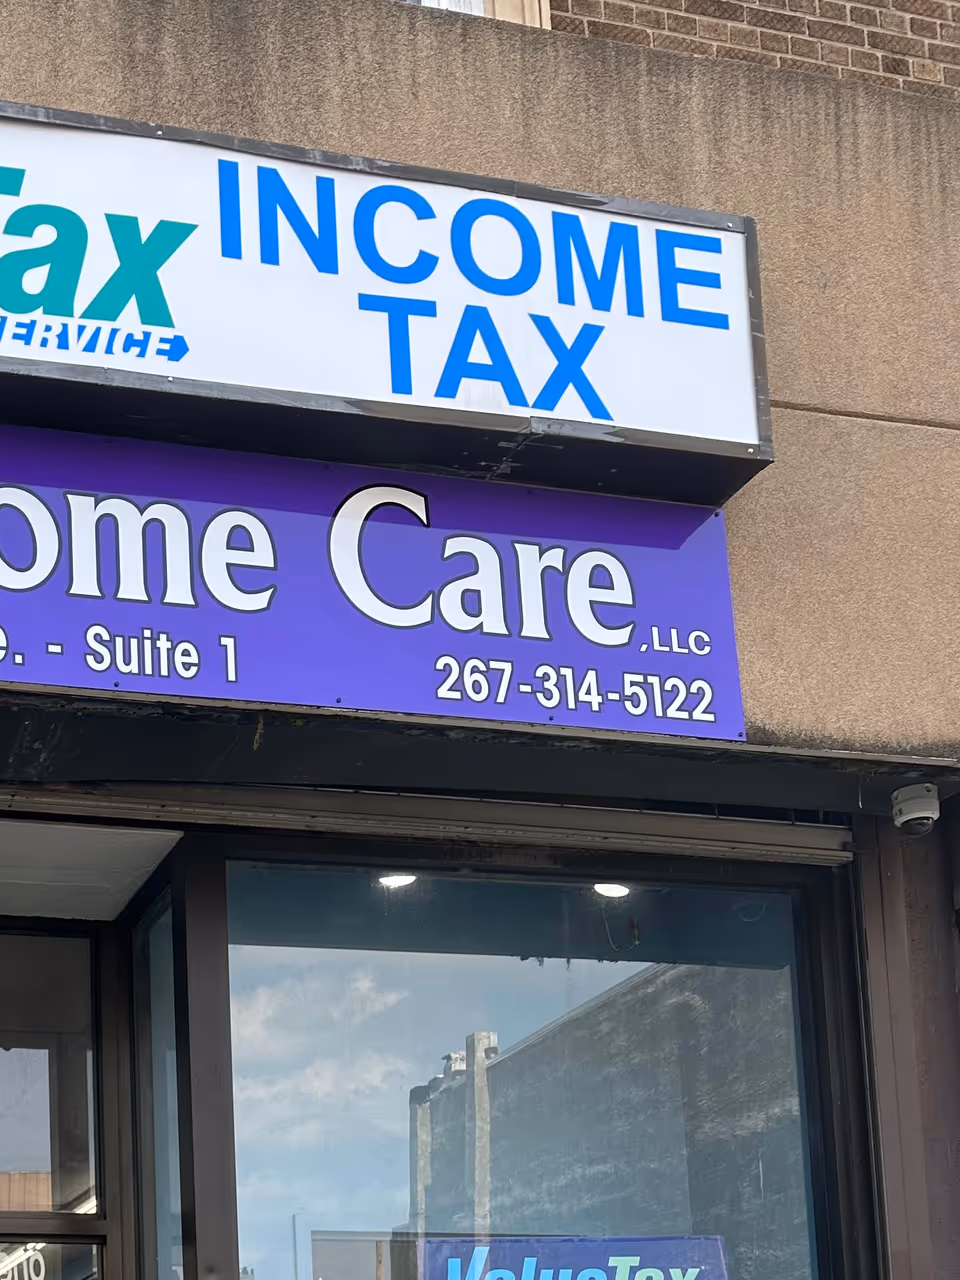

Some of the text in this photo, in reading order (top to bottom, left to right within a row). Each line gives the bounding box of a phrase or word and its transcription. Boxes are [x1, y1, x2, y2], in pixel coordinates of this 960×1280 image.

[217, 158, 730, 330] INCOME
[358, 292, 614, 421] TAX
[327, 483, 637, 649] Care
[46, 641, 65, 657] -
[83, 622, 201, 680] Suite
[217, 634, 240, 683] 1
[433, 653, 717, 724] 267-314-5122
